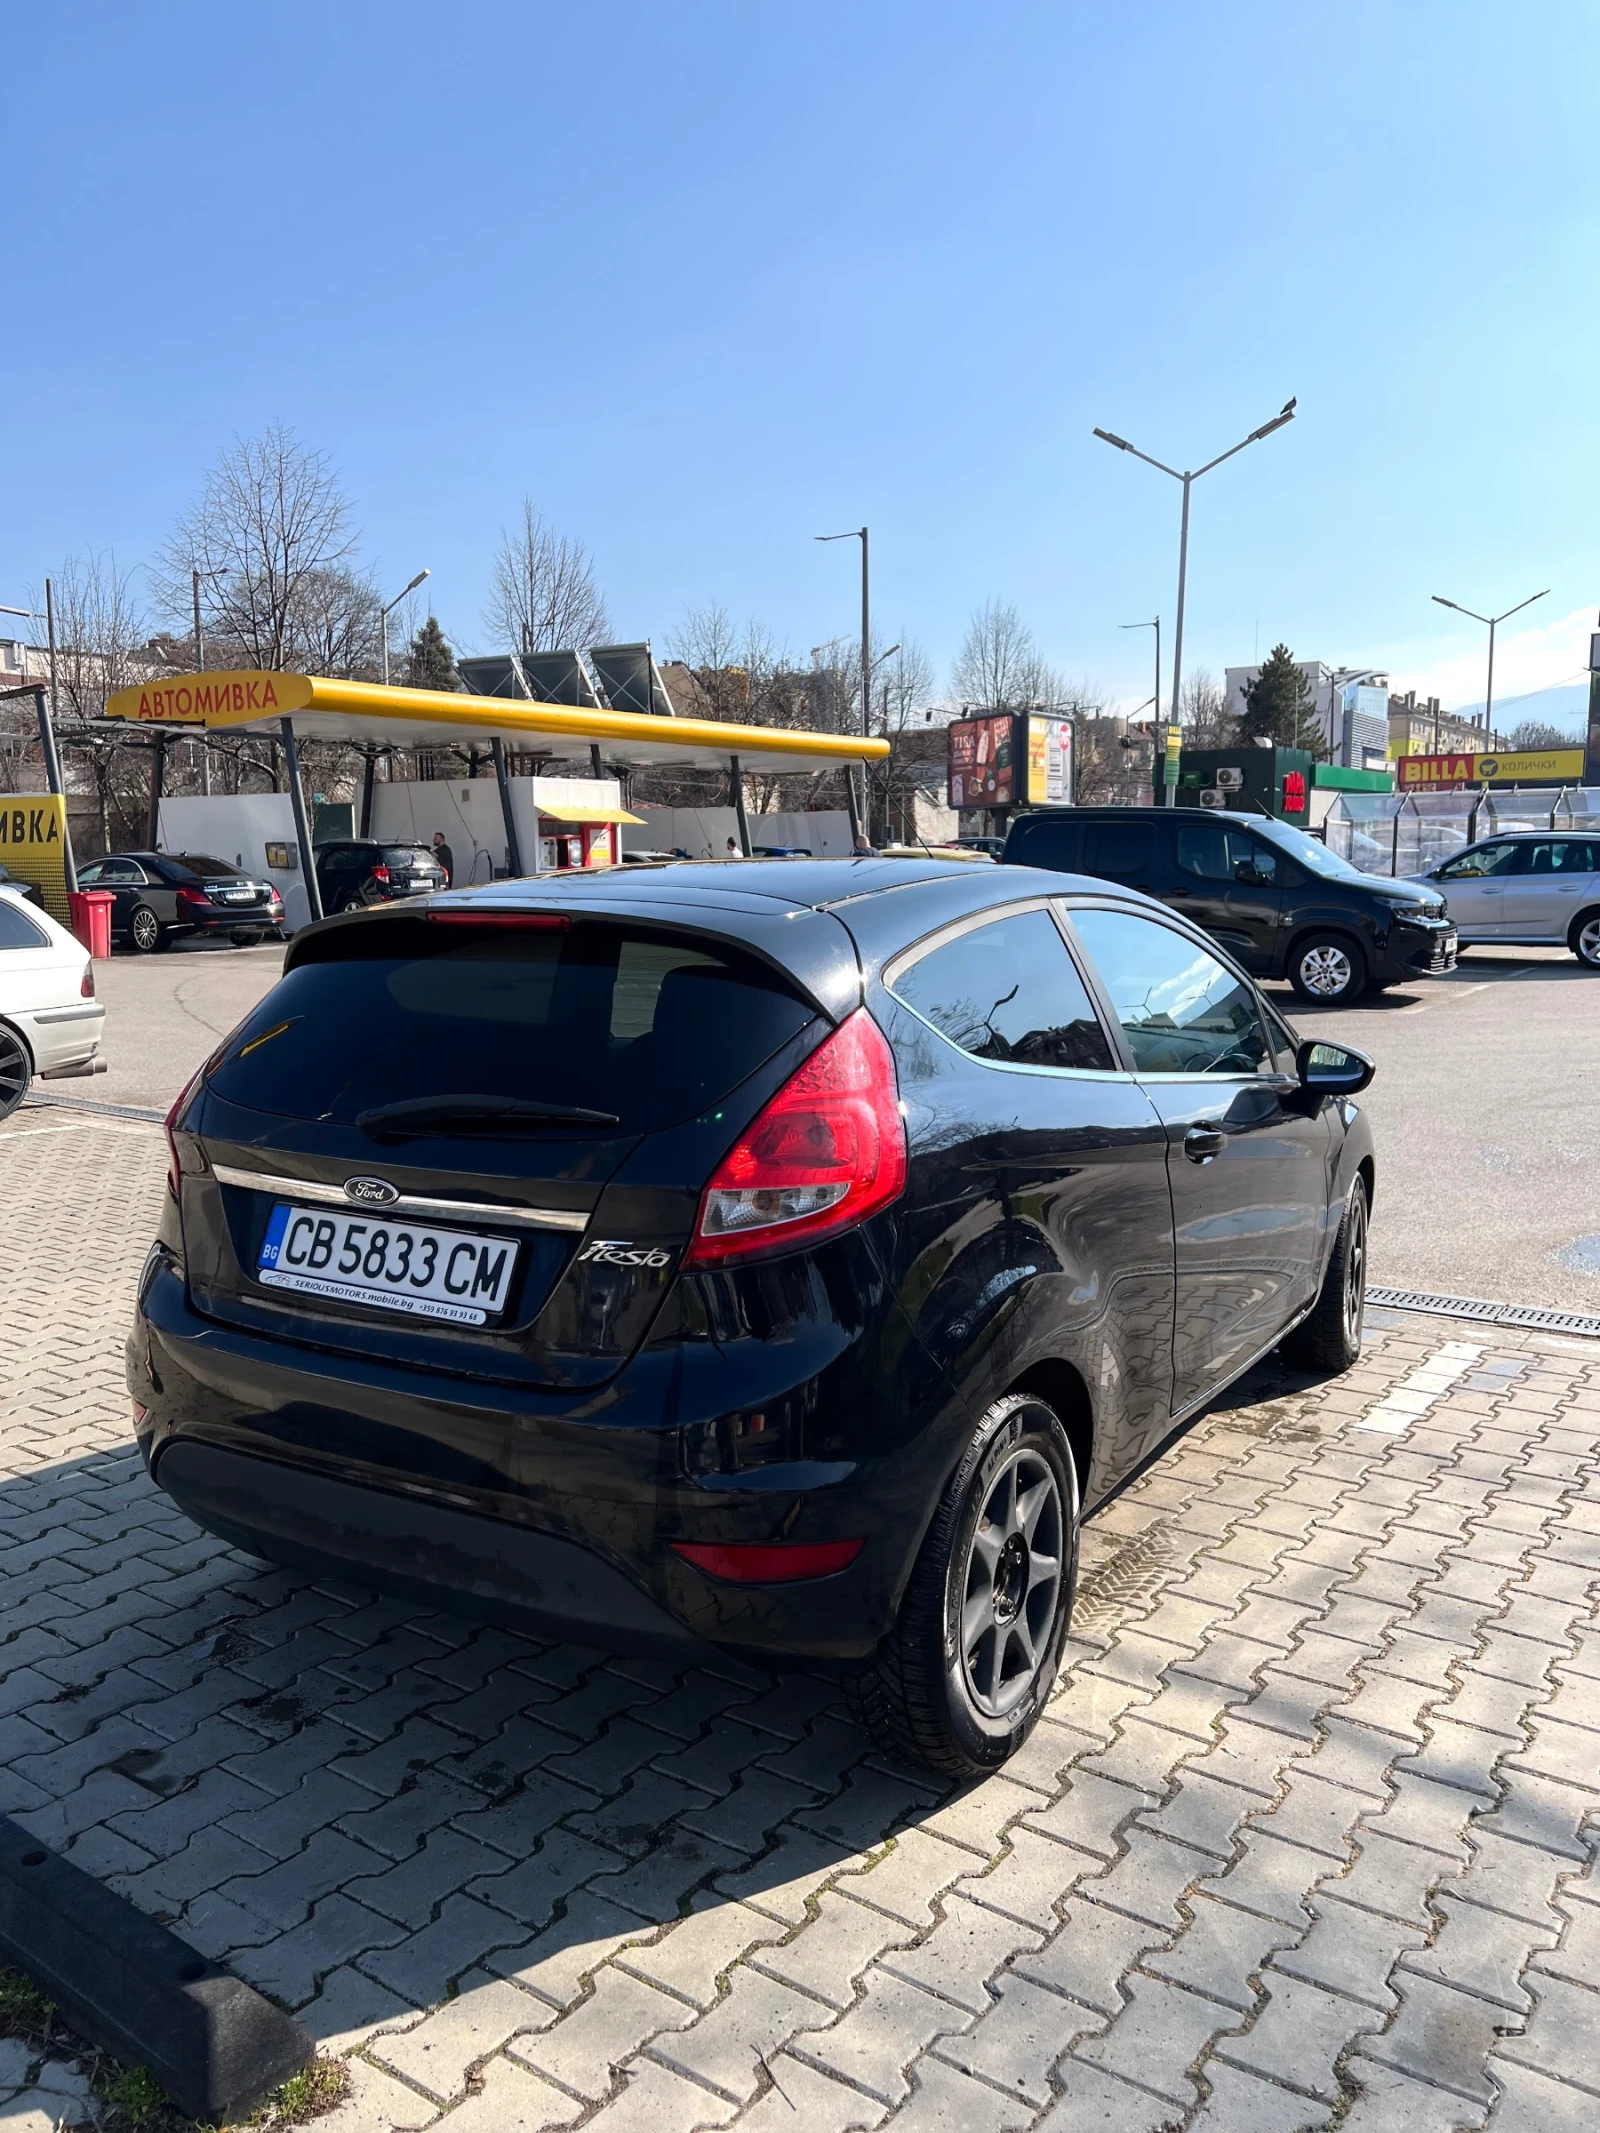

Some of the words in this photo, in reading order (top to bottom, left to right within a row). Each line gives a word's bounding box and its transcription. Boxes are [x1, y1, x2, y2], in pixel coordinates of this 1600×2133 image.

[138, 679, 279, 718] АВТОМИВКА
[1404, 759, 1469, 782] BILLA
[355, 1181, 385, 1200] Ford
[262, 1244, 279, 1260] BG
[577, 1240, 671, 1267] Fiesta
[435, 1306, 448, 1316] 876
